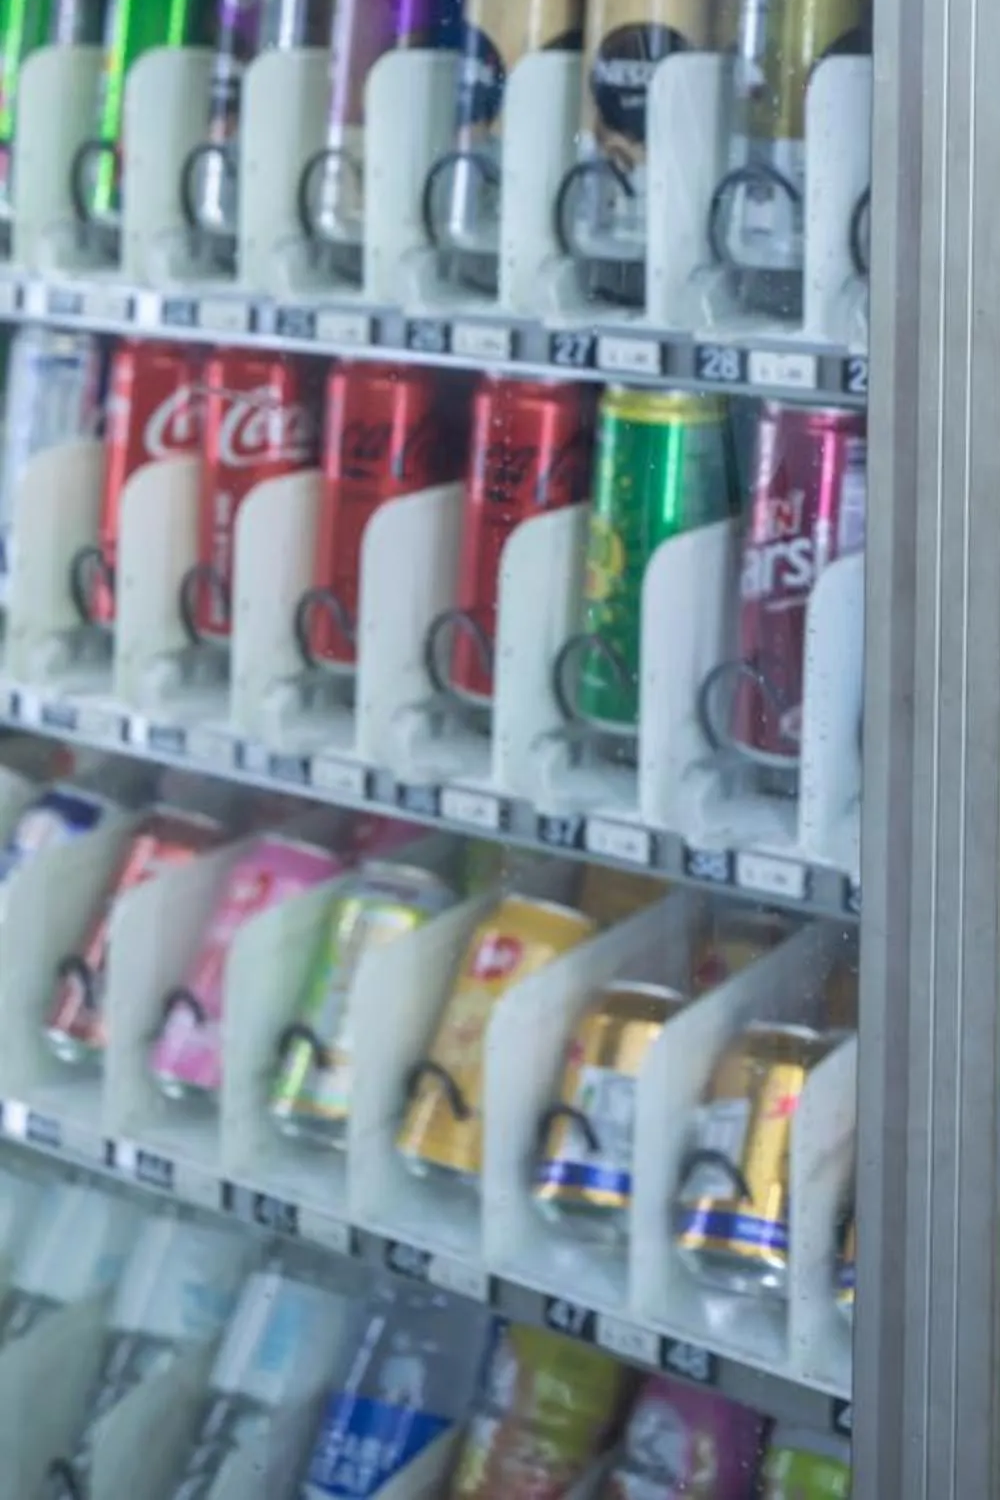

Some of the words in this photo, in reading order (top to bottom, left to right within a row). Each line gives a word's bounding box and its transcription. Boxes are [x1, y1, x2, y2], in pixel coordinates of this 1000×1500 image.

[555, 331, 591, 366] 27
[701, 347, 740, 381] 28
[849, 358, 868, 393] 2
